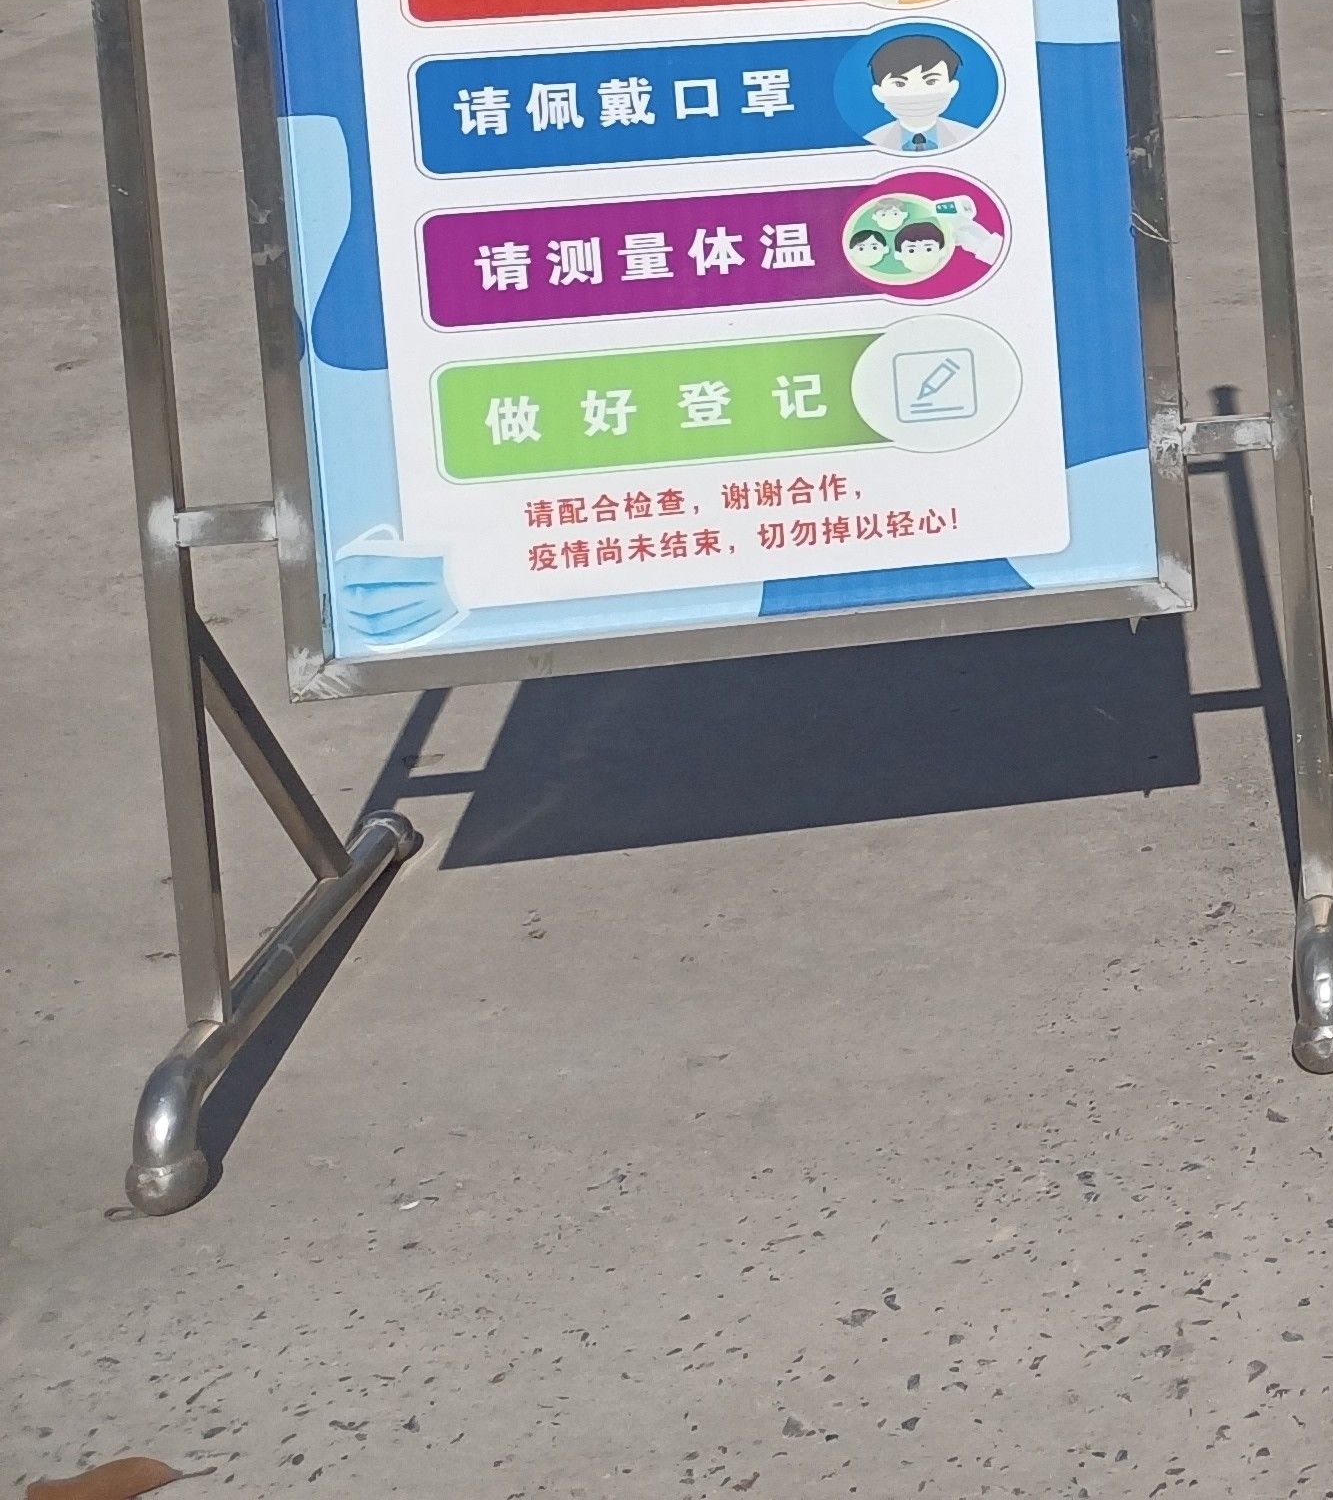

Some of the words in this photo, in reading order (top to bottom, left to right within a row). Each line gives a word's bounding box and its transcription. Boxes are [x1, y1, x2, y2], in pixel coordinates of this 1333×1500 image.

[453, 68, 796, 136] 请佩戴口罩
[473, 221, 818, 292] 请测量体温
[484, 374, 829, 446] 做好登记
[524, 473, 863, 529] 请配合检查，谢谢合作，
